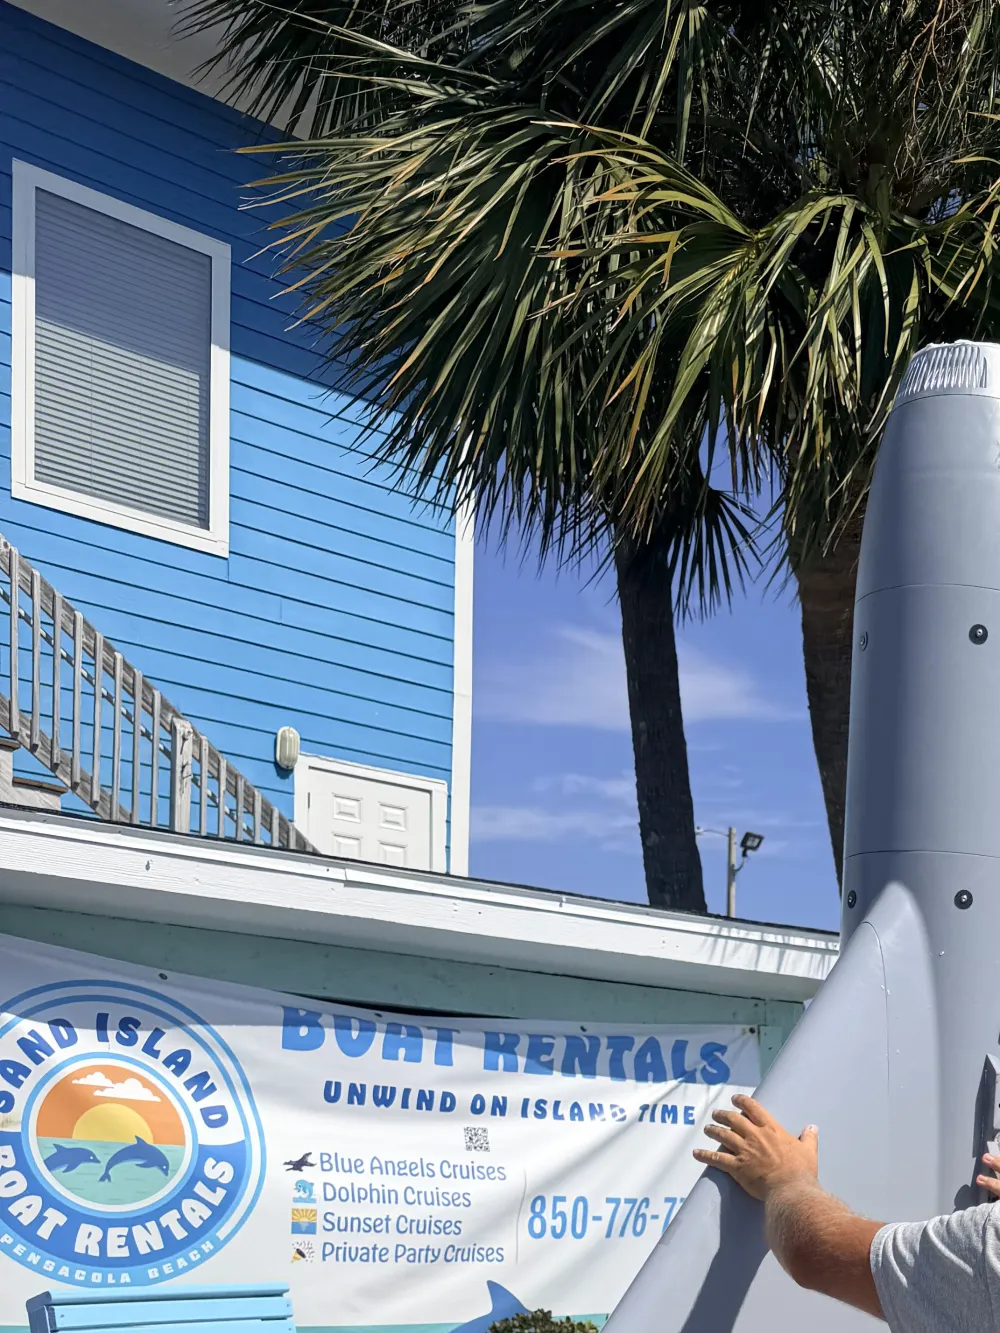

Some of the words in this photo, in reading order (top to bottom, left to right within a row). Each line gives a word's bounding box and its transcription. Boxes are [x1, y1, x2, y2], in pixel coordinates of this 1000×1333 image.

[282, 1006, 460, 1066] BOAT
[483, 1031, 731, 1086] RENTALS
[96, 1012, 229, 1129] ISLAND
[323, 1080, 457, 1113] UNWIND
[470, 1093, 508, 1117] ON
[521, 1098, 628, 1122] ISLAND
[638, 1104, 696, 1126] TIME
[320, 1152, 365, 1174] Blue
[370, 1156, 436, 1178] Angels
[439, 1160, 507, 1181] Cruises
[74, 1157, 235, 1258] RENTALS
[322, 1182, 399, 1205] Dolphin
[403, 1186, 472, 1208] Cruises
[527, 1194, 685, 1240] 850-776-7
[322, 1212, 391, 1235] Sunset
[395, 1215, 463, 1236] Cruises
[0, 1233, 131, 1284] PENSACOLA
[148, 1240, 214, 1280] BEACH
[322, 1242, 389, 1263] Private
[394, 1244, 441, 1264] Party
[443, 1243, 505, 1263] Cruises
